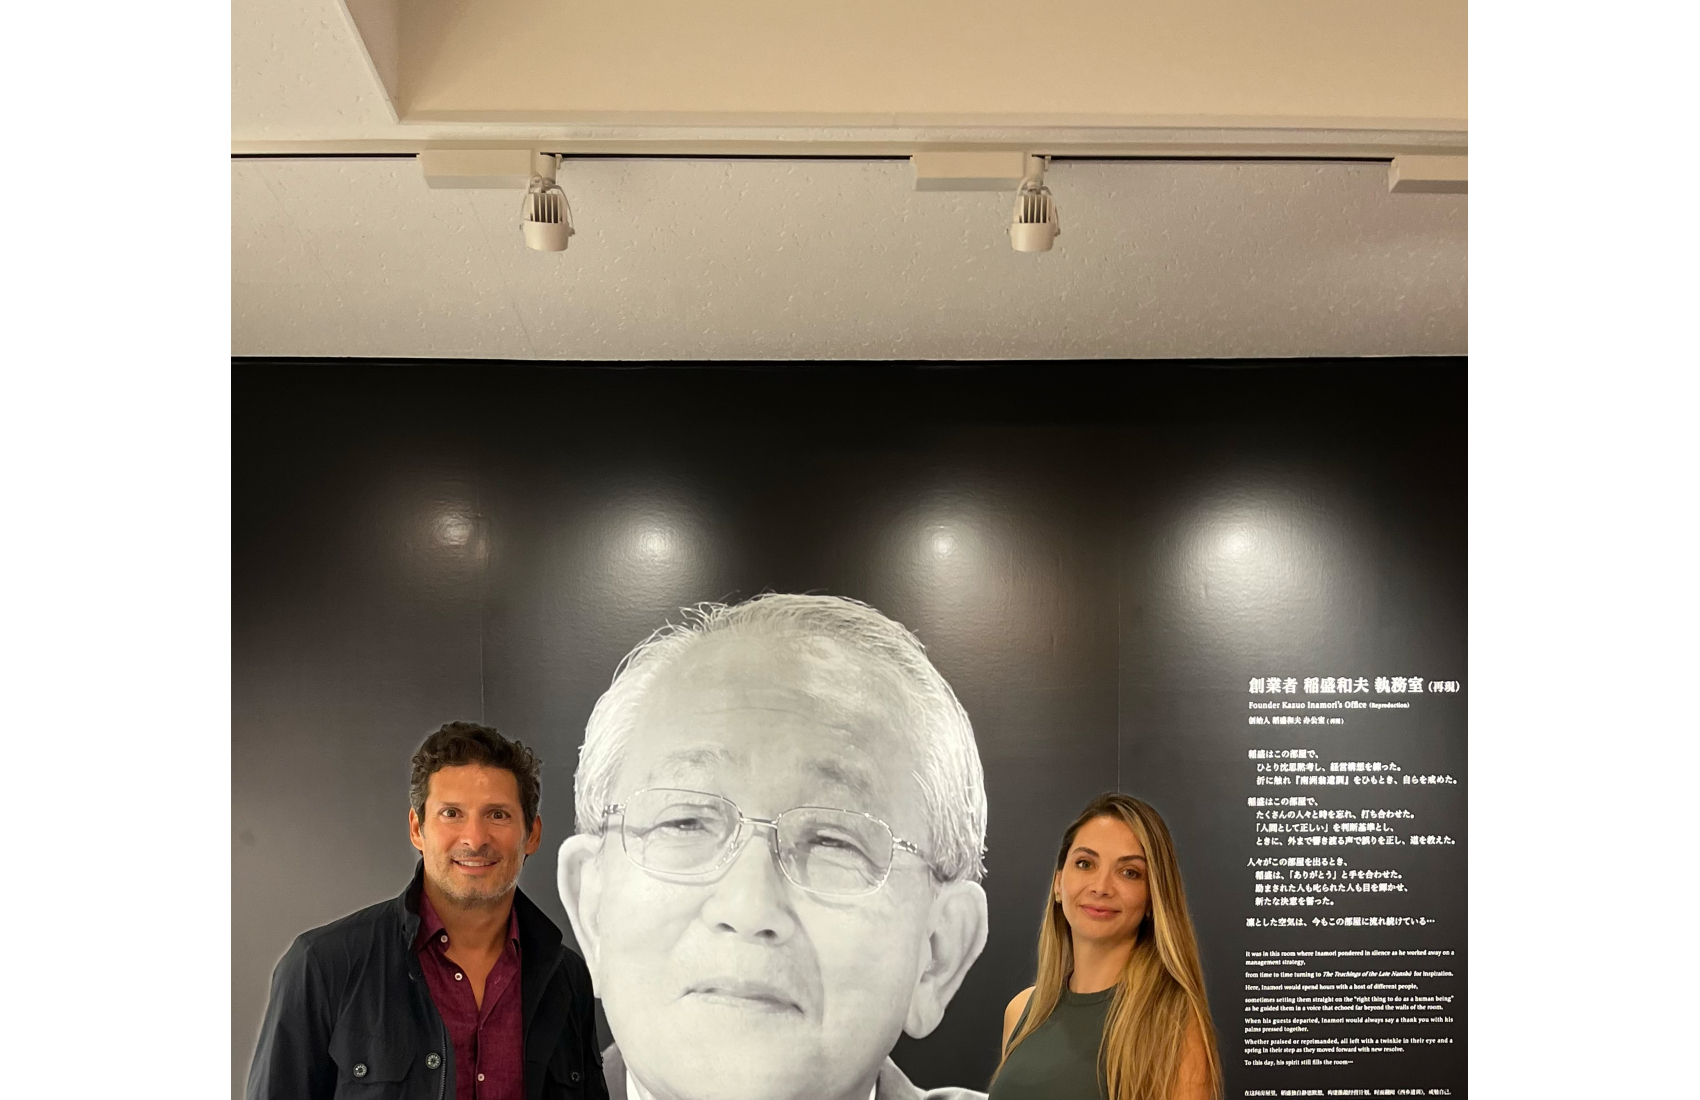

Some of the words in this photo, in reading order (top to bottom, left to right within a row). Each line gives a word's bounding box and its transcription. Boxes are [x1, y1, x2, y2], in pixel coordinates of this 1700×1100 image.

[1249, 677, 1298, 694] 創業者
[1303, 677, 1369, 694] 稲盛和夫
[1374, 676, 1424, 694] 執務室
[1249, 701, 1280, 709] Founder
[1282, 701, 1306, 709] Kazuo
[1307, 700, 1343, 709] Inamori's
[1344, 700, 1367, 709] Office
[1294, 971, 1314, 979] turning
[1312, 996, 1334, 1004] straight
[1260, 1005, 1279, 1013] guided
[1364, 1004, 1384, 1012] beyond
[1292, 1017, 1320, 1025] departed,
[1270, 1038, 1292, 1046] praised
